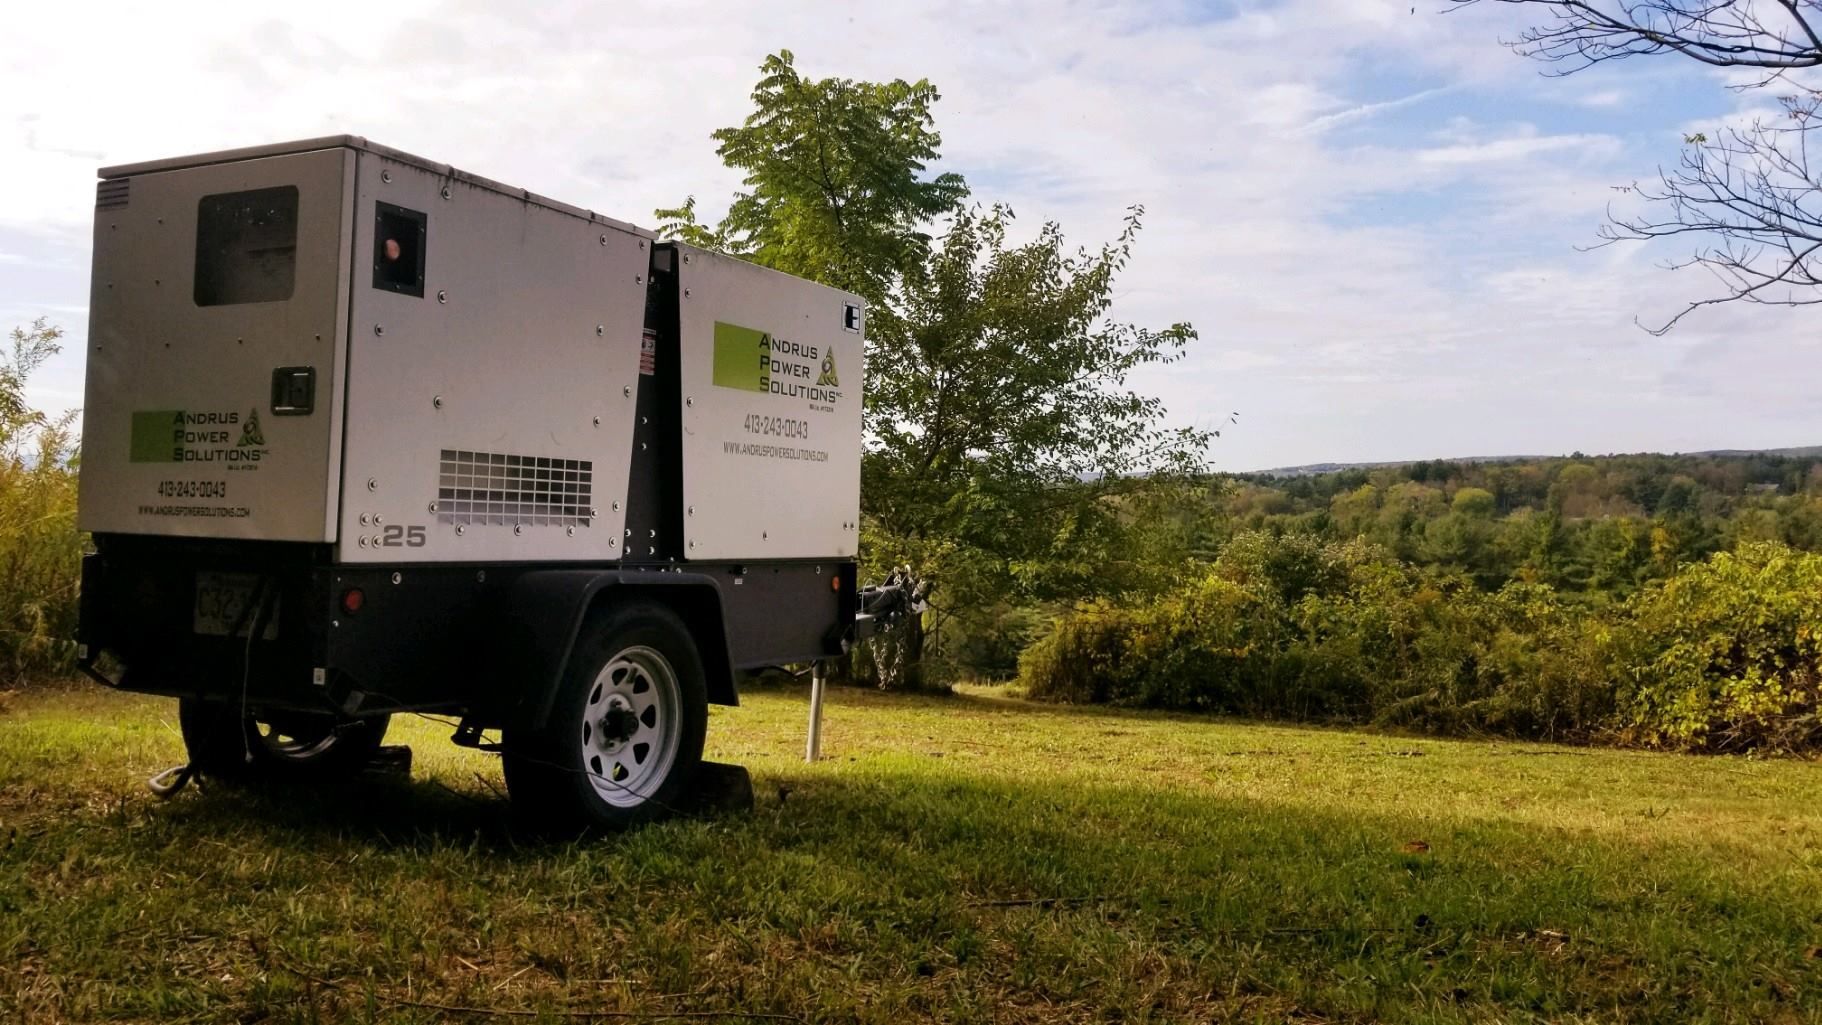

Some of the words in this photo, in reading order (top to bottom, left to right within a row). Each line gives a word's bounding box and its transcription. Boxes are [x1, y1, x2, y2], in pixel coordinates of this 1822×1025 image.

[759, 334, 818, 360] ANDRUS
[759, 355, 810, 379] POWER
[759, 377, 836, 403] SOLUTIONS
[173, 412, 239, 425] ANDRUS
[173, 431, 230, 443] POWER
[173, 450, 261, 462] SOLUTIONS
[723, 441, 829, 463] WWW.ANDRUSPOWERSOLUTIONS.COM
[383, 525, 426, 547] 25
